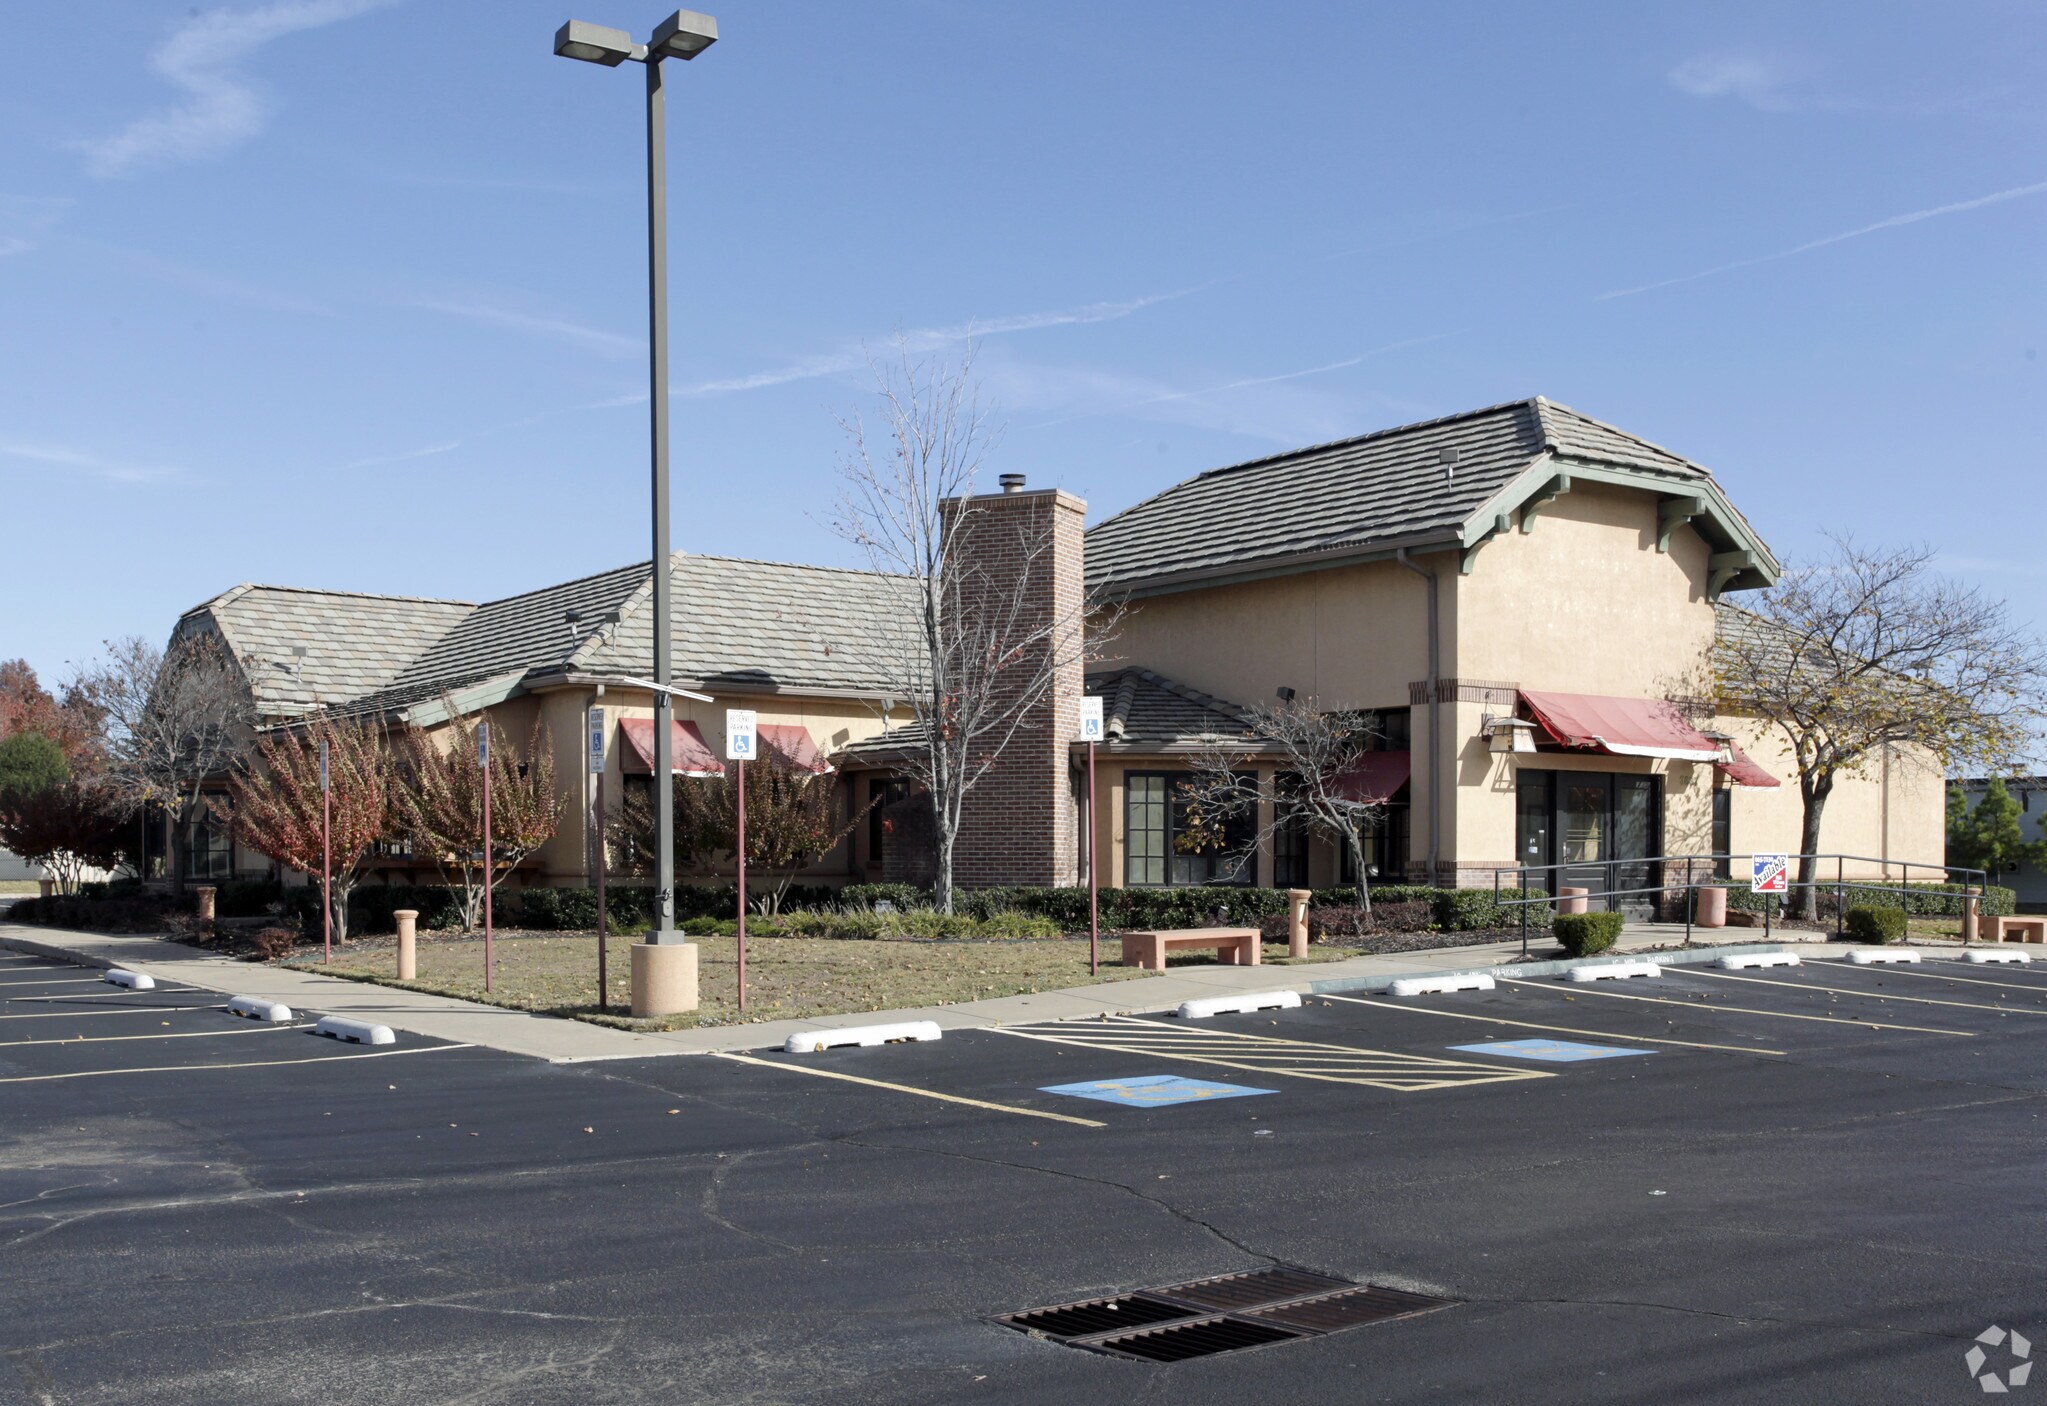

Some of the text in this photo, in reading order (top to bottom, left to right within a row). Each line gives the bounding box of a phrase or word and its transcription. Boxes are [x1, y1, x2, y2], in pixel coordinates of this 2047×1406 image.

[730, 714, 753, 723] RESERVED
[730, 723, 752, 732] PARKING
[1754, 858, 1786, 889] Available
[1647, 955, 1674, 963] PARKING
[1491, 968, 1522, 977] PARKING
